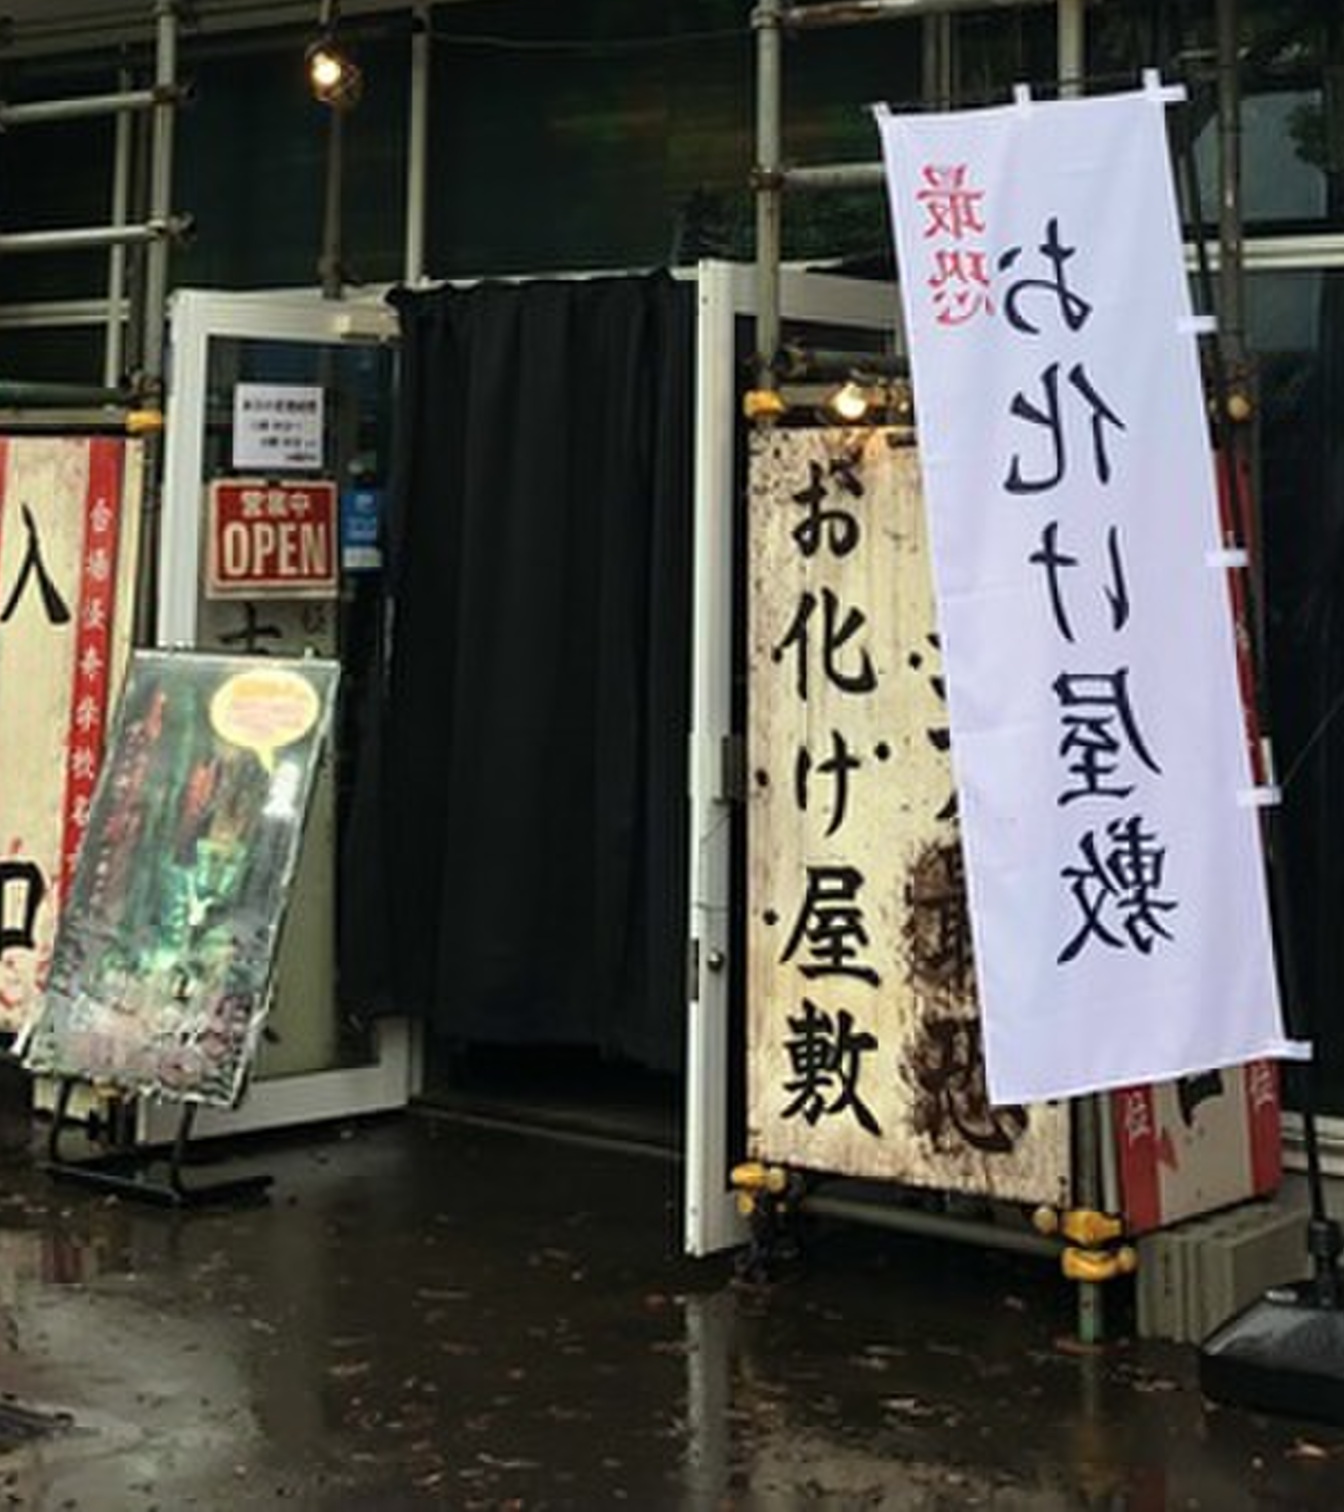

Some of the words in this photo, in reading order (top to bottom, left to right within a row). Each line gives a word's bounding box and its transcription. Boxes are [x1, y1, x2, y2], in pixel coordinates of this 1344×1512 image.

[222, 521, 329, 578] OPEN
[779, 459, 884, 1140] お化け屋敷
